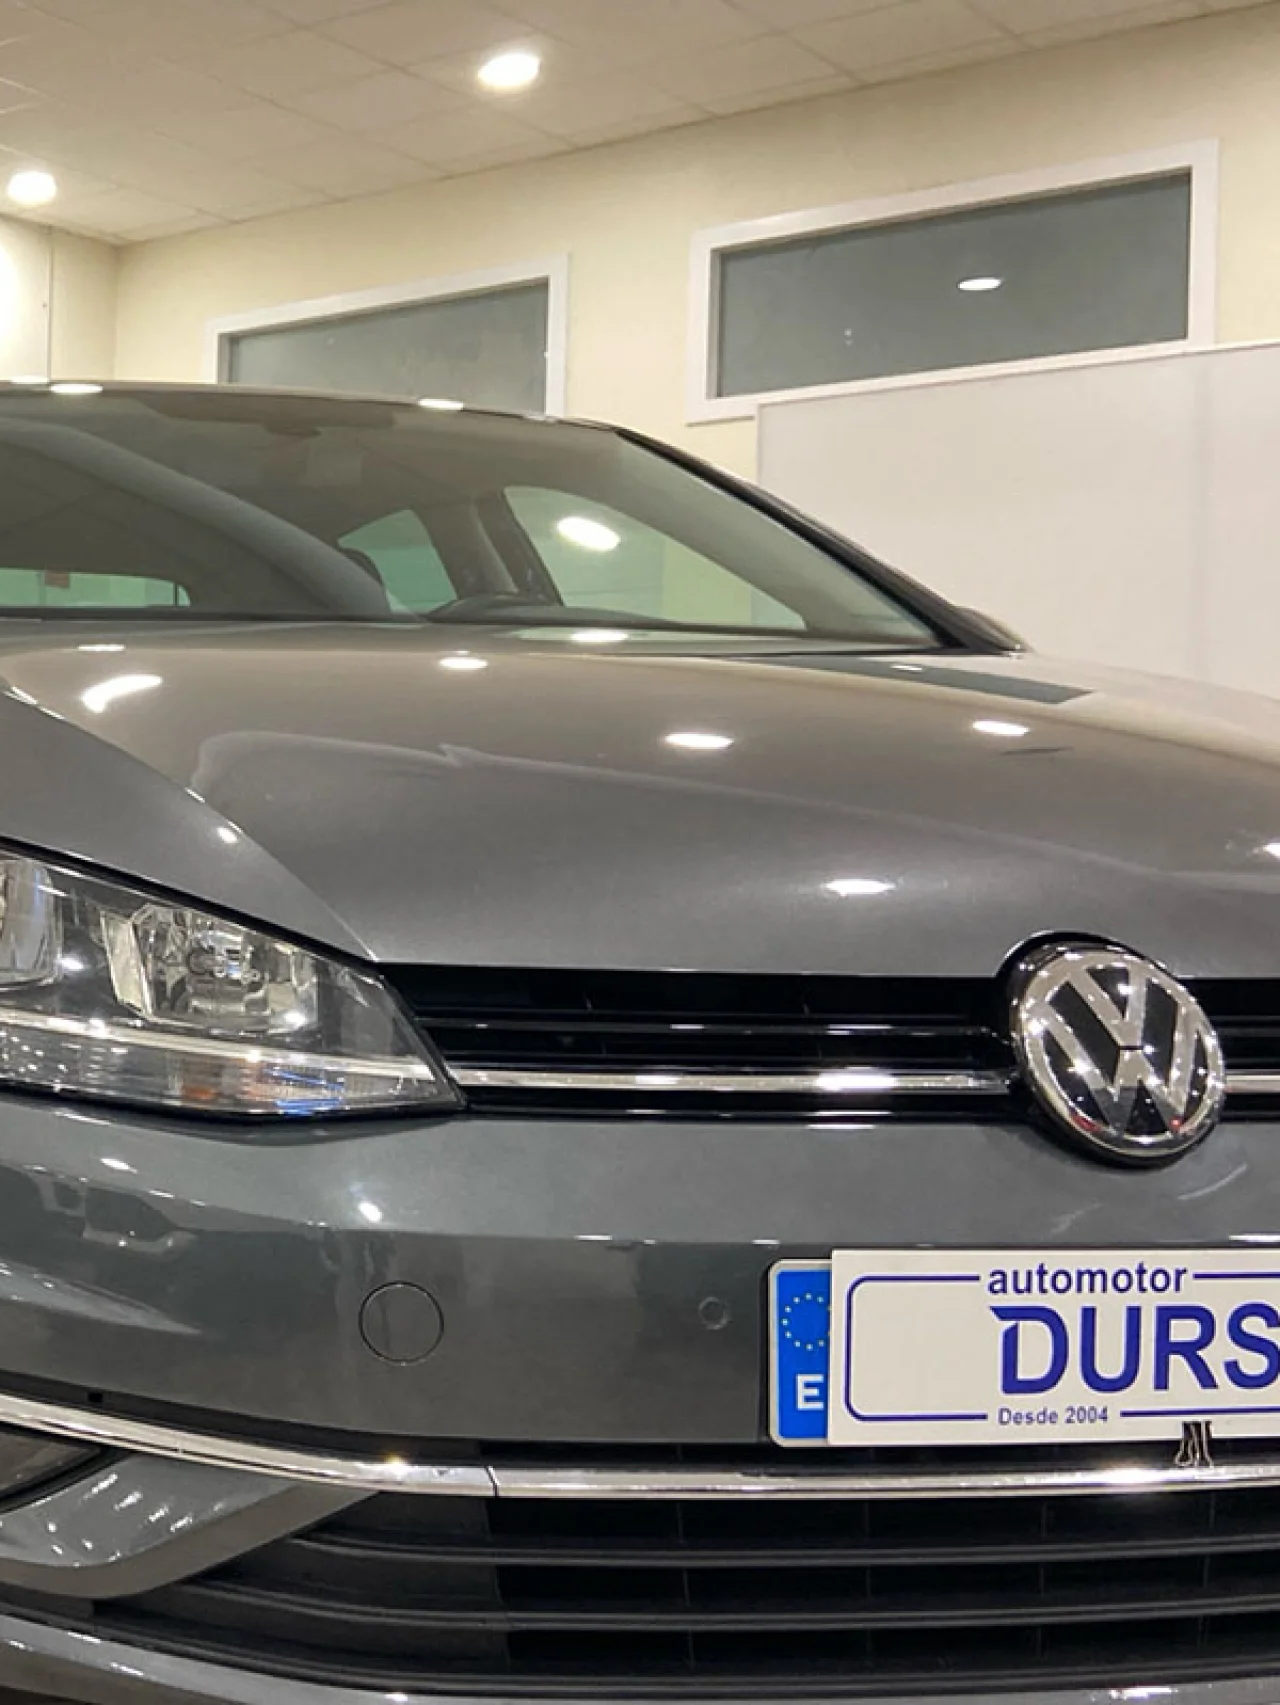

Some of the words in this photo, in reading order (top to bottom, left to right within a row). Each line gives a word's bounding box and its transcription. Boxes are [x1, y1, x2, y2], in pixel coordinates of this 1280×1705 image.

[1022, 951, 1224, 1142] VW
[987, 1261, 1188, 1294] automotor
[989, 1303, 1280, 1395] DURS
[796, 1374, 825, 1411] E
[998, 1407, 1059, 1426] Desde
[1065, 1405, 1108, 1425] 2004
